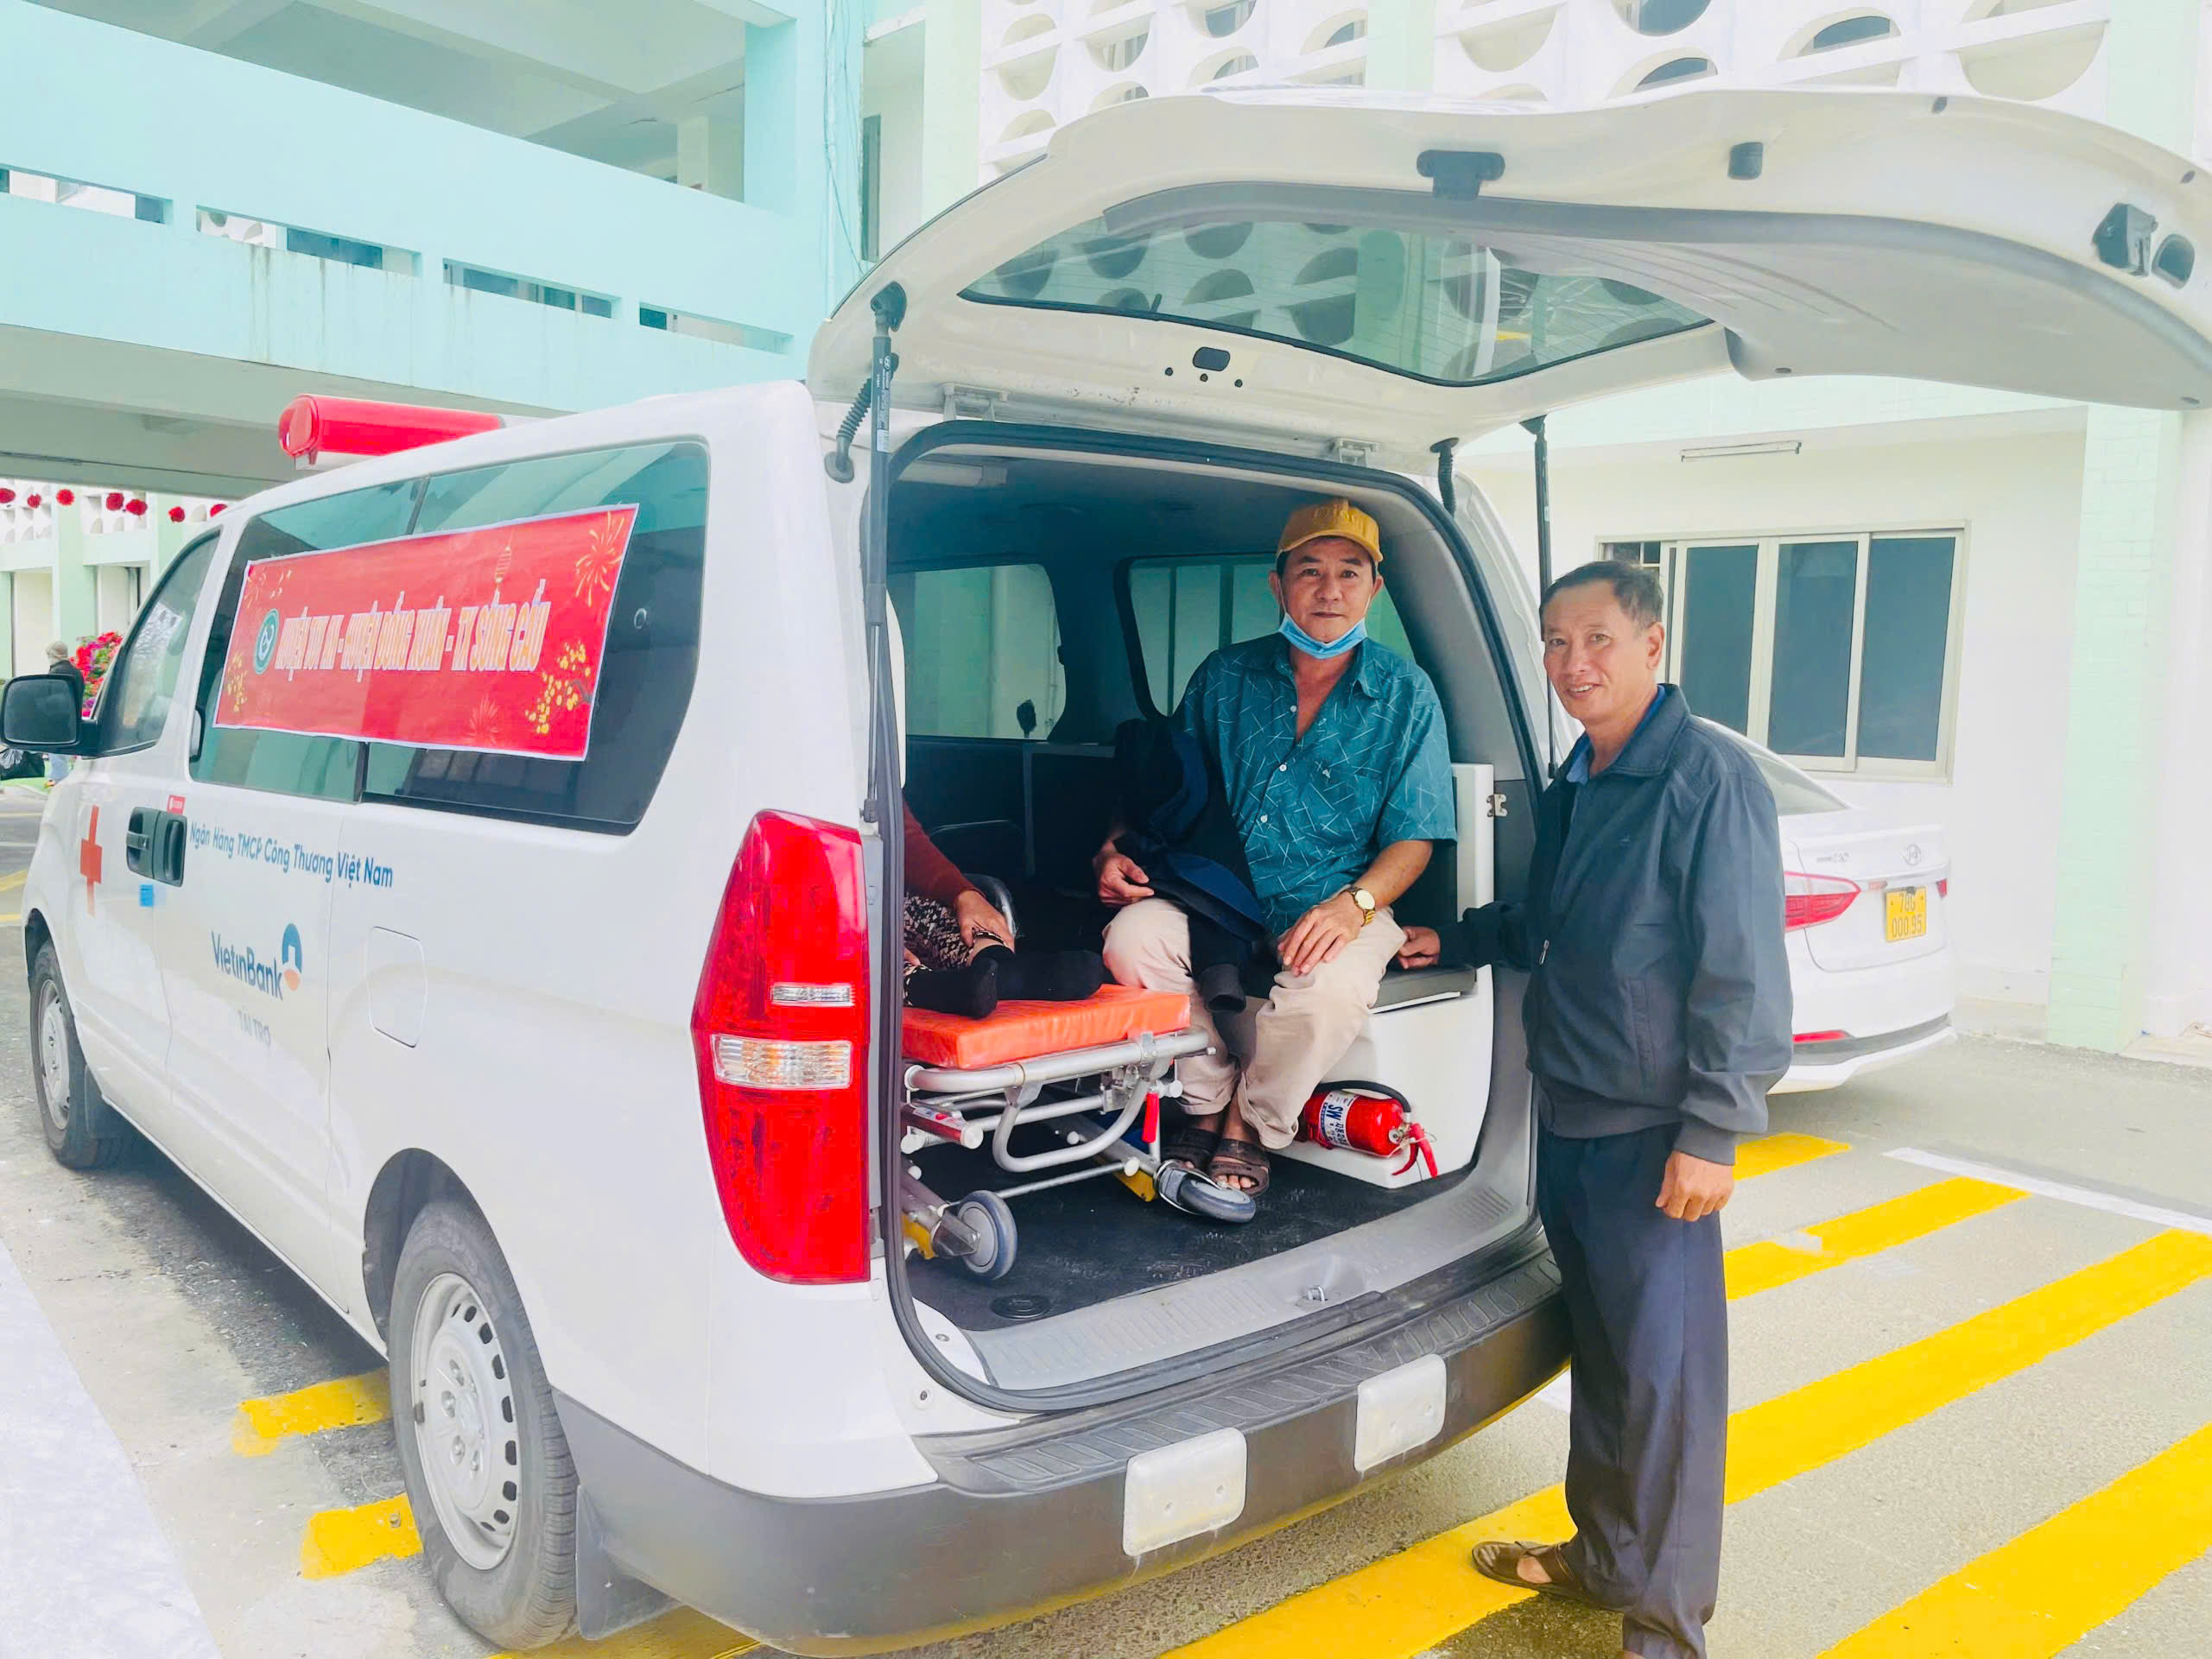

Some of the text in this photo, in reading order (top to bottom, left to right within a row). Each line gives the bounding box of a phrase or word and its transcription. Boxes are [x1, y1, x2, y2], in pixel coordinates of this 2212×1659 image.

[470, 589, 517, 671] SÔNG
[509, 579, 552, 671] CẦU
[190, 821, 394, 889] Ngân Hàng TMCP Công Thương Việt Nam
[211, 929, 283, 1001] VietinBank
